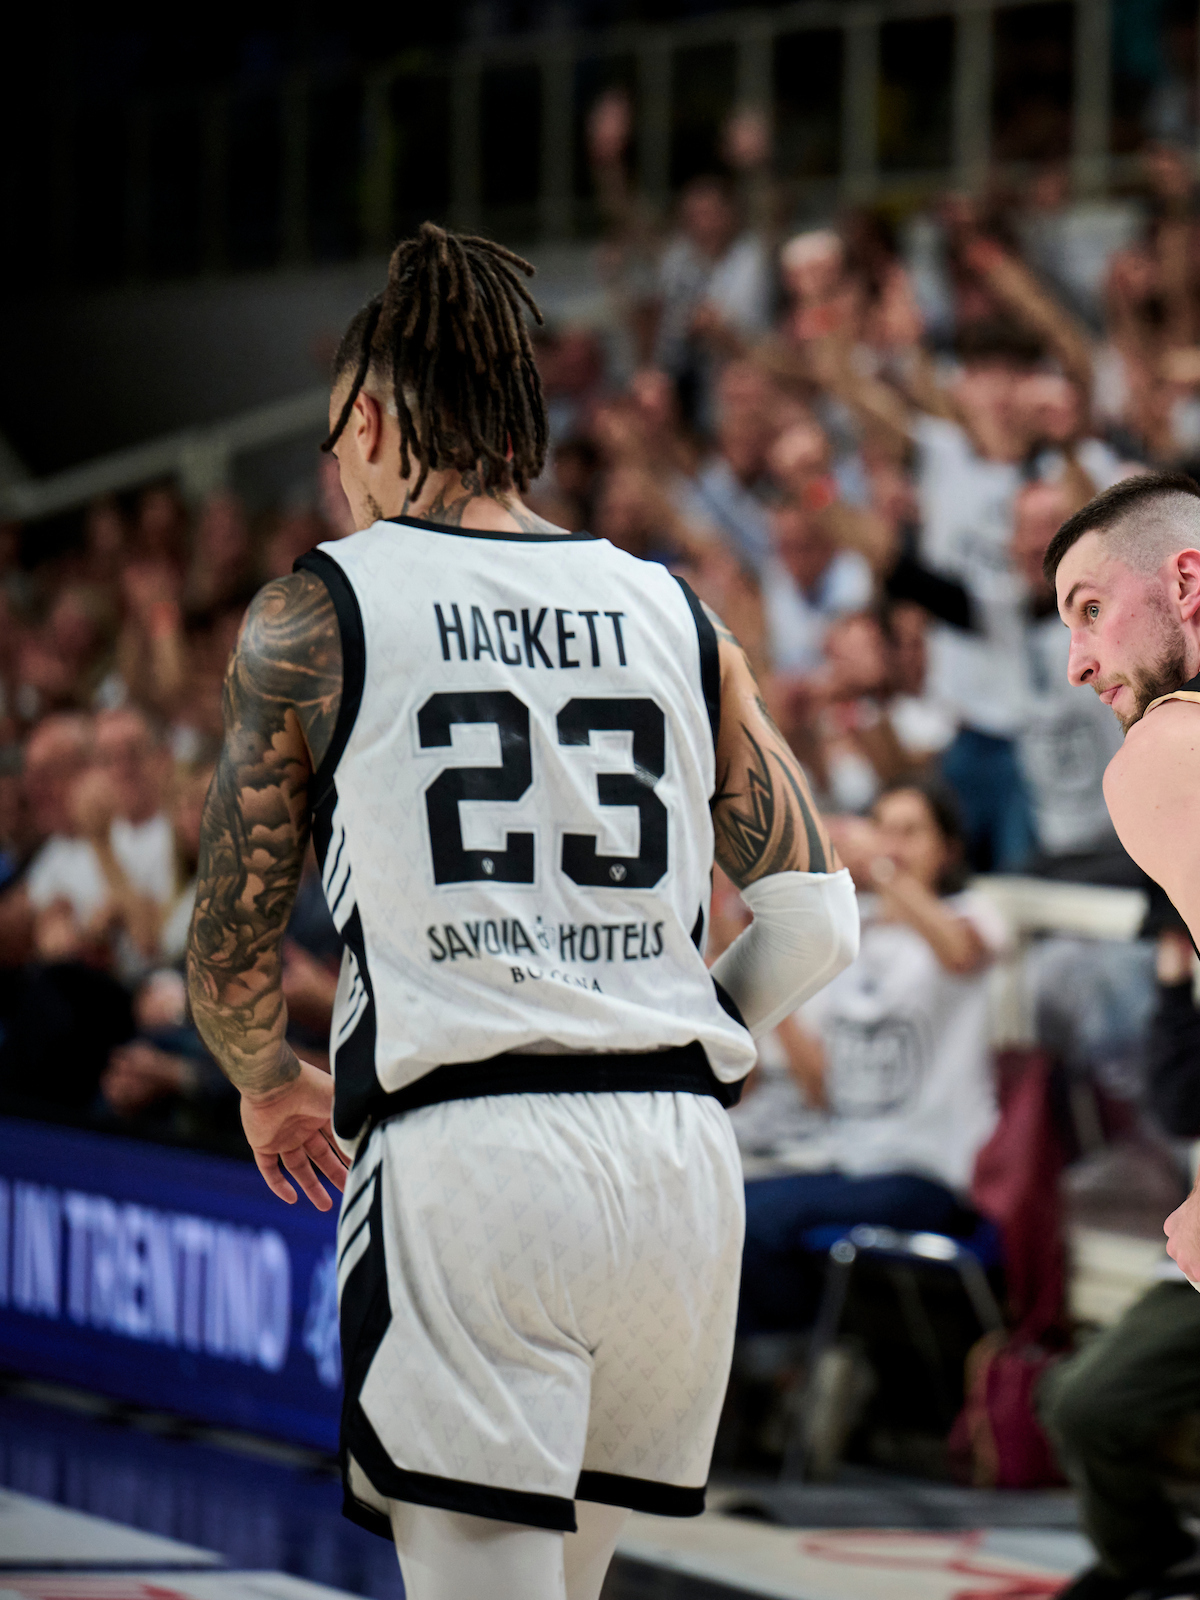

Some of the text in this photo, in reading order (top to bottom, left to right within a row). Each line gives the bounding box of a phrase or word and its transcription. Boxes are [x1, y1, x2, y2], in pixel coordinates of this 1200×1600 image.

[434, 603, 628, 669] HACKETT
[417, 690, 668, 889] 23
[427, 918, 665, 962] SAVOIA HOTELS
[64, 1188, 290, 1371] TRENTINO
